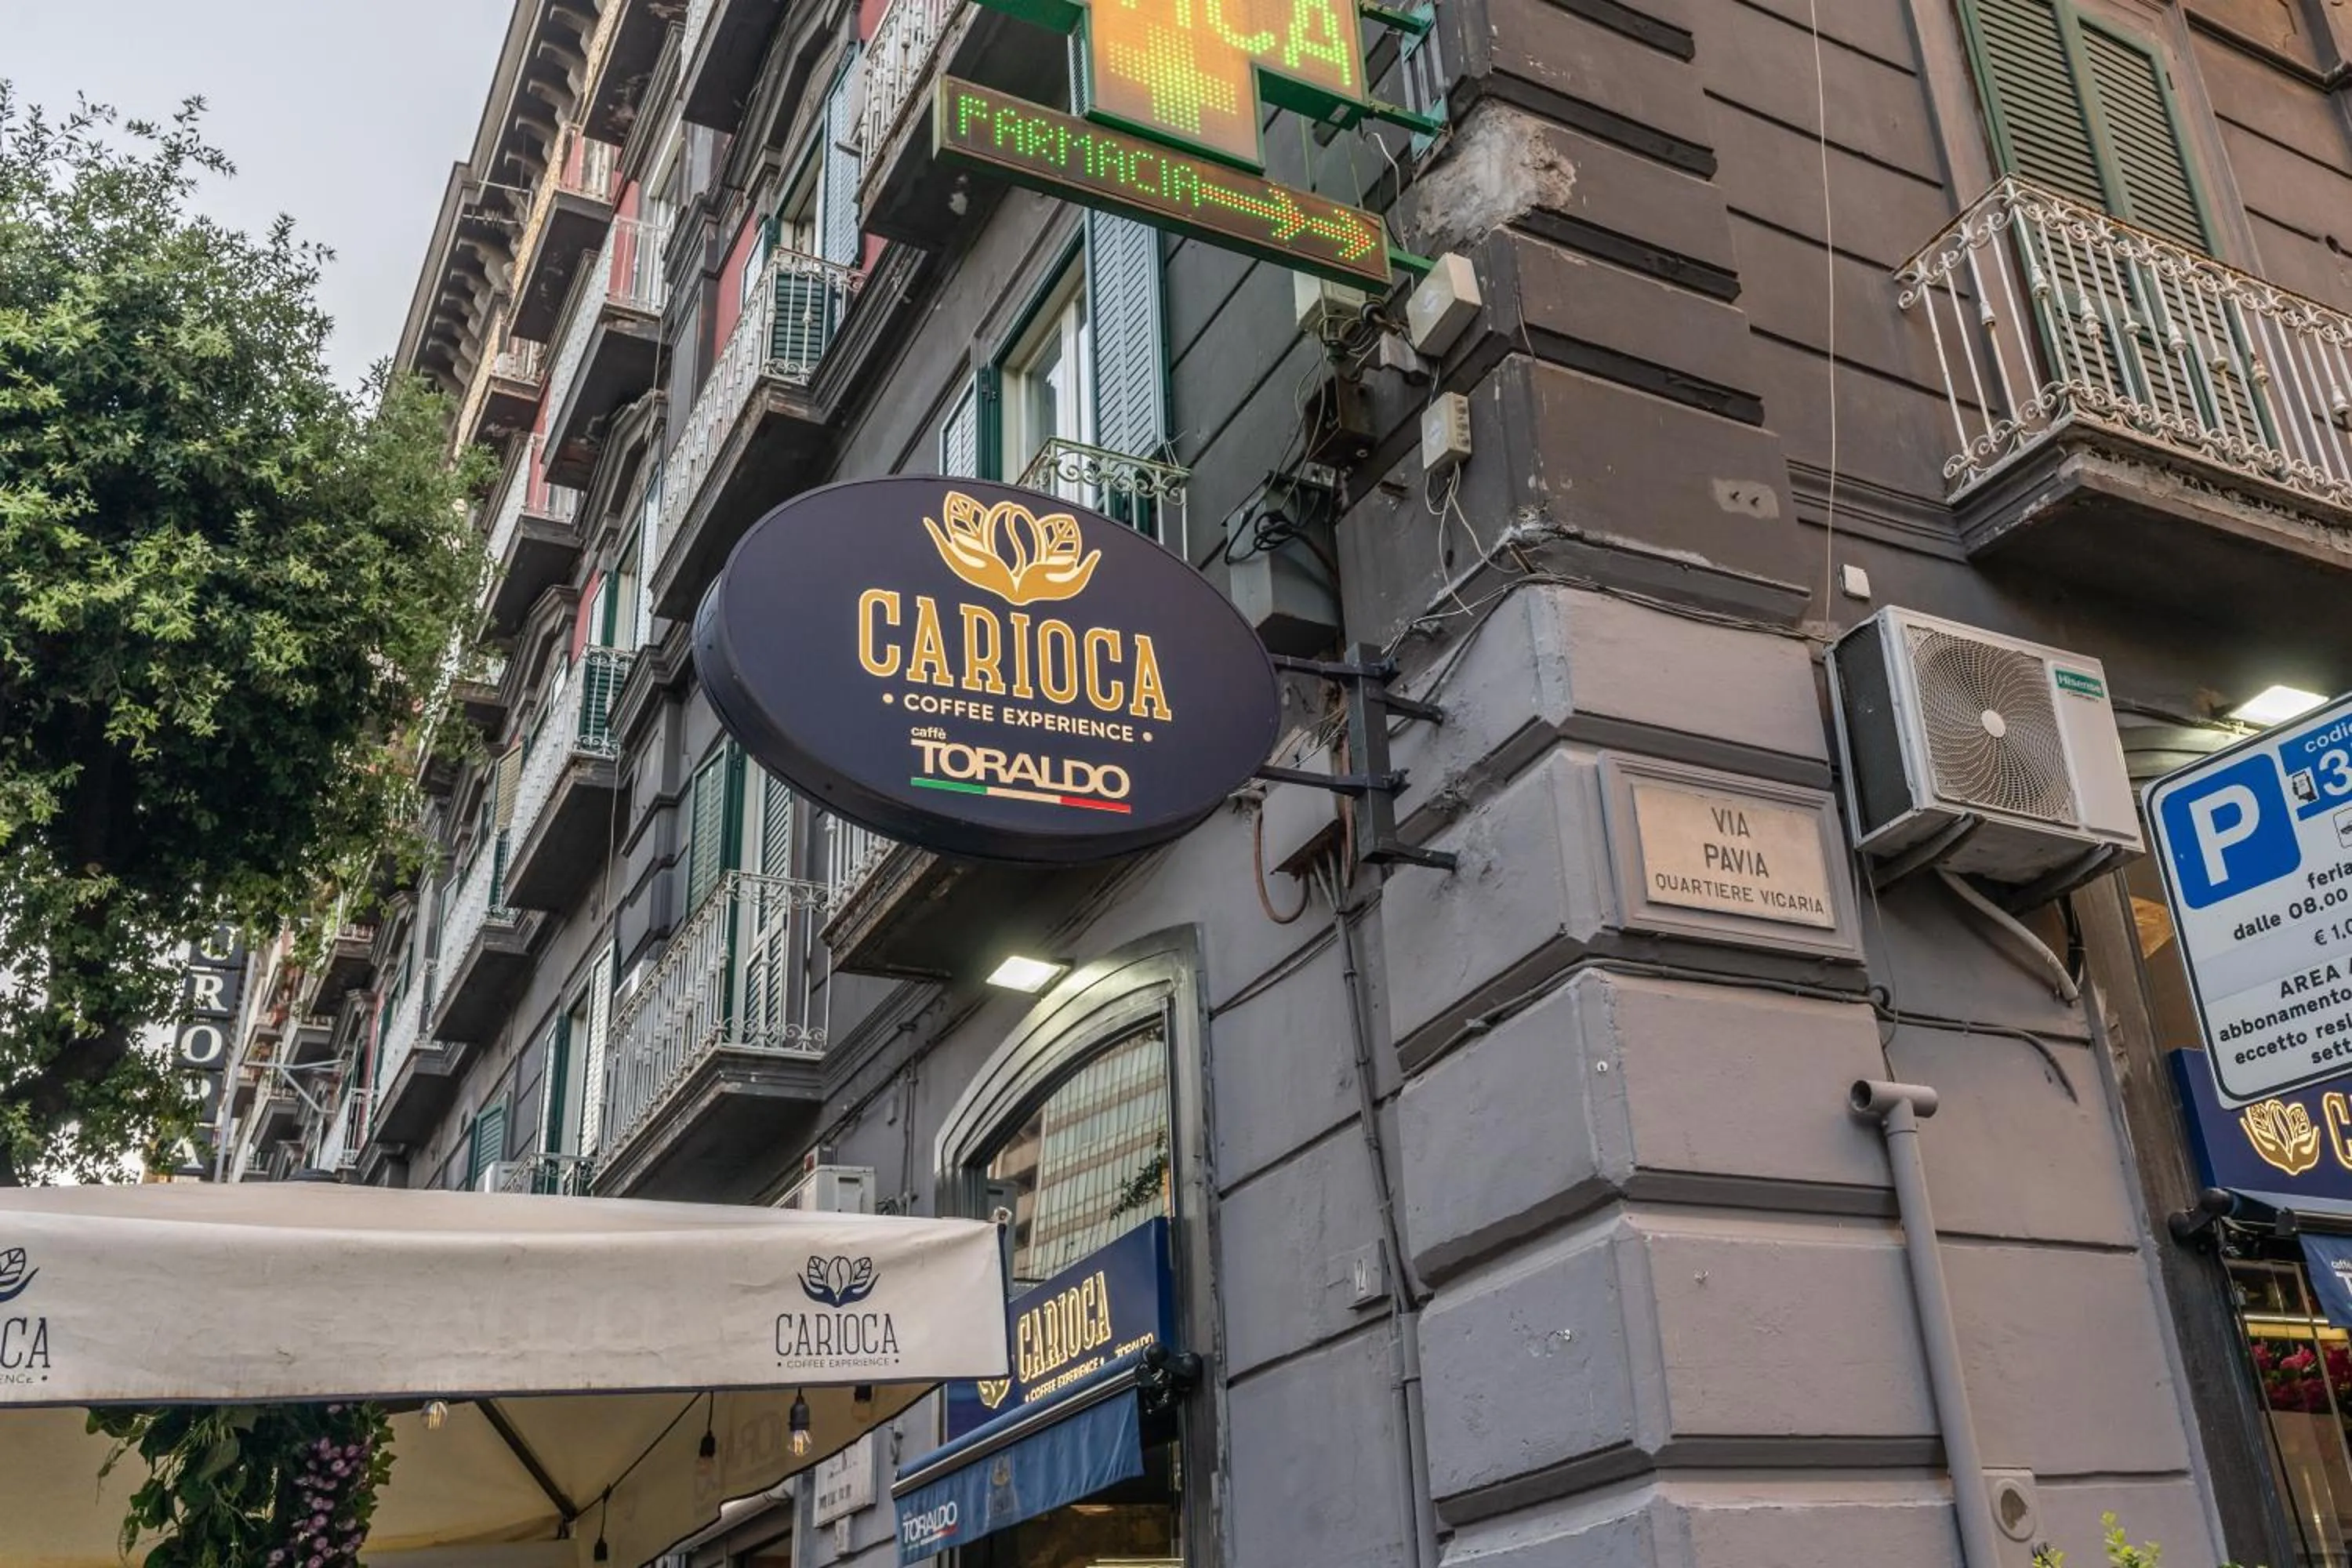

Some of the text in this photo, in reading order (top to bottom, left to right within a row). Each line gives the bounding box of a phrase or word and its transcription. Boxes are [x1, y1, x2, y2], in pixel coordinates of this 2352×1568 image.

[959, 95, 1201, 208] FARMACIA
[858, 589, 1172, 721] CARIOCA
[903, 694, 1134, 742] COFFEE EXPERIENCE
[910, 727, 946, 740] caffè
[910, 739, 1131, 799] TORALDO
[1711, 807, 1750, 838] VIA
[2189, 785, 2260, 887] P
[1704, 843, 1769, 878] PAVIA
[1656, 873, 1825, 915] QUARTIERE VICARIA
[2234, 888, 2348, 941] dalle 08.00
[2314, 929, 2328, 946] €
[2281, 964, 2341, 1000] AREA
[2220, 988, 2352, 1041] abbonamento
[2235, 1032, 2307, 1064] eccetto
[2311, 1037, 2352, 1064] sett
[775, 1312, 899, 1356] CARIOCA
[1018, 1270, 1112, 1384] CARIOCA
[0, 1373, 34, 1384] NCE
[786, 1357, 890, 1369] COFFEE EXPERIENCE
[903, 1501, 958, 1544] TORALDO
